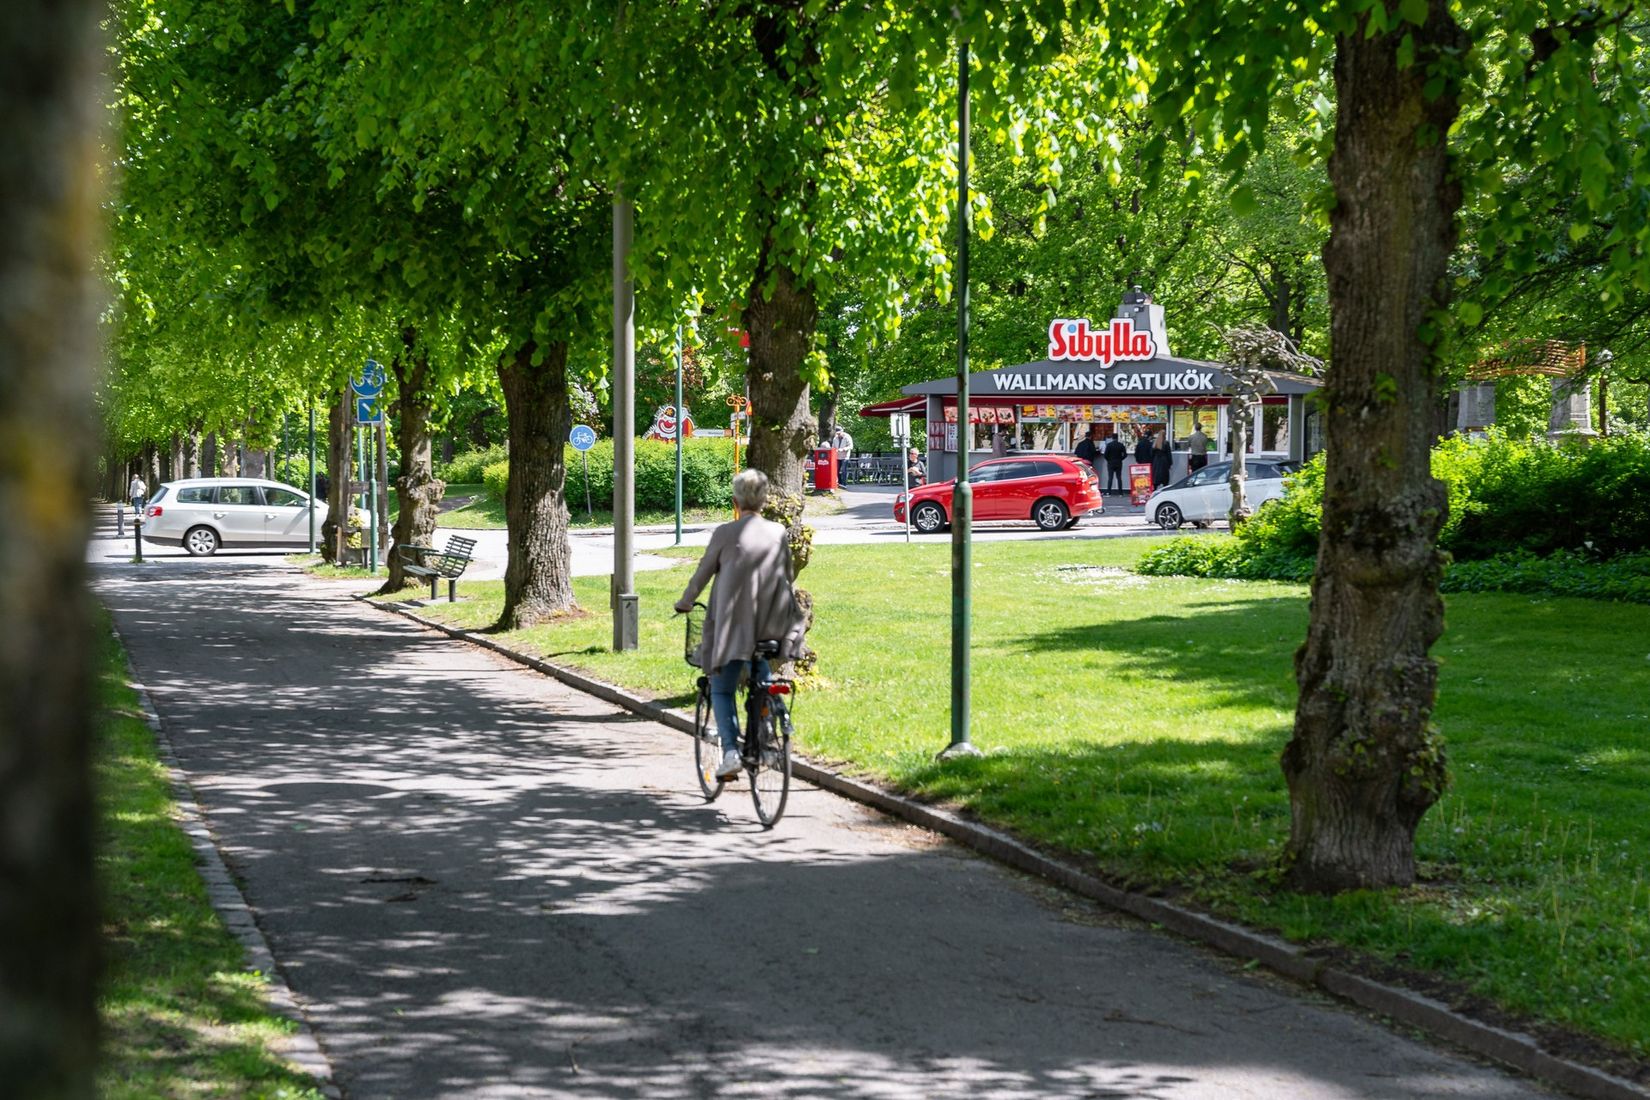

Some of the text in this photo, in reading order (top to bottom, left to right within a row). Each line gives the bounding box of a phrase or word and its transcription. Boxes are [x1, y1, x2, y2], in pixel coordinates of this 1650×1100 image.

[1051, 321, 1153, 365] Sibylla
[993, 369, 1214, 391] WALLMANS GATUKÖK
